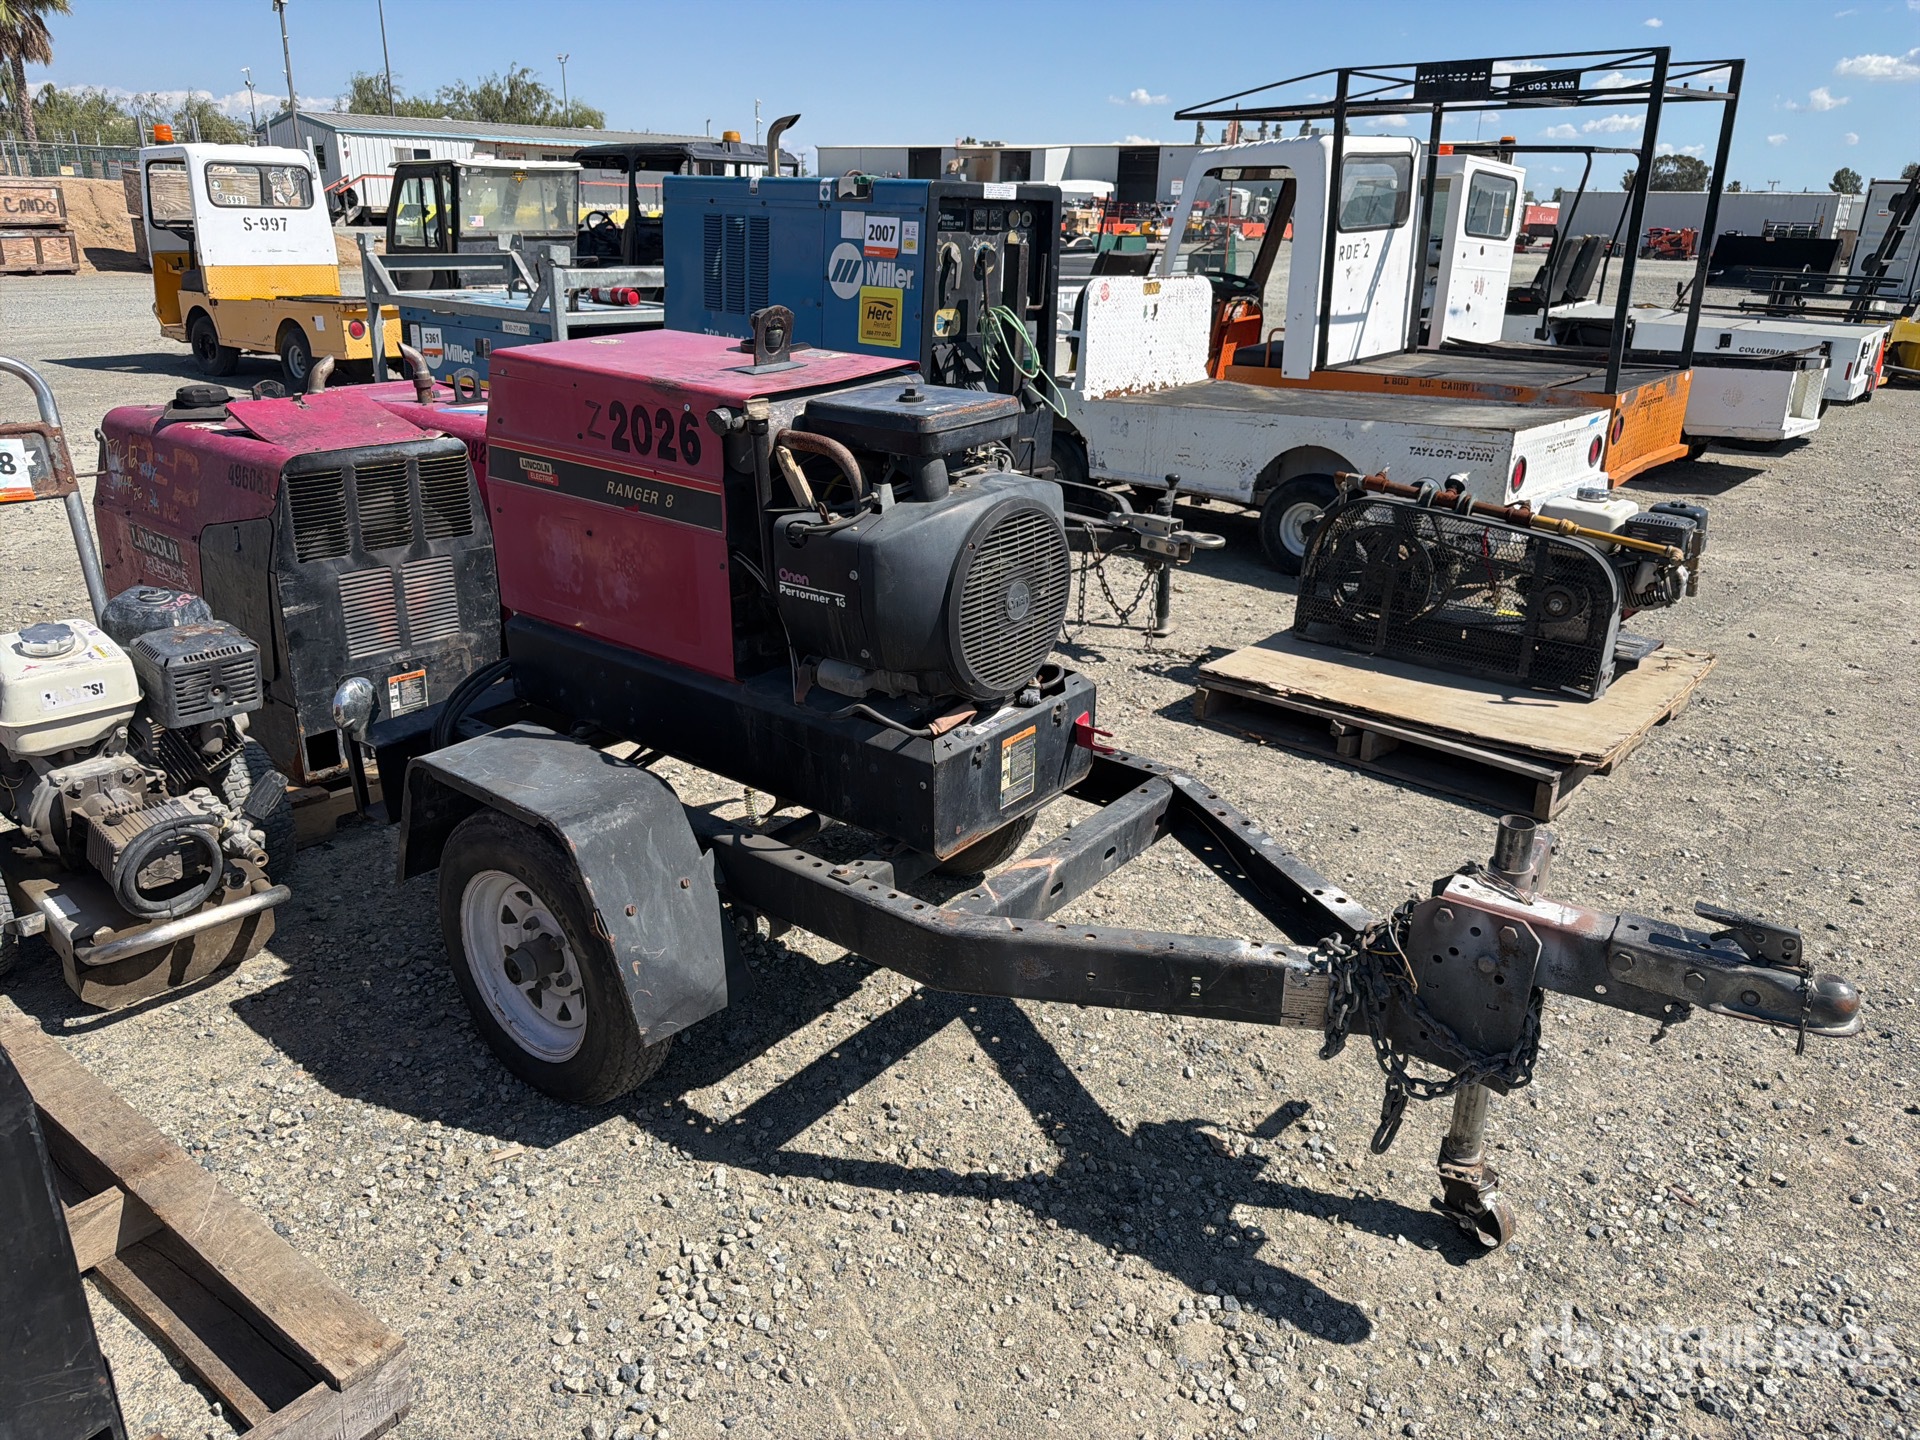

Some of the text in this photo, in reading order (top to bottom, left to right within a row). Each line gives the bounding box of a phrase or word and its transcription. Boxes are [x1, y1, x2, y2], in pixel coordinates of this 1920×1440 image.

[3, 197, 56, 213] CONDO
[226, 195, 246, 204] S997
[243, 216, 287, 231] S-997
[868, 224, 896, 242] 2007
[866, 260, 914, 289] Miller
[867, 305, 893, 321] Herc
[425, 333, 440, 344] 5361
[444, 343, 475, 364] Miller
[1409, 446, 1495, 463] TAYLOR-DUNN
[521, 459, 551, 473] LINCOLN
[529, 473, 554, 484] ELECTRIC
[606, 481, 674, 508] RANGER 8
[778, 567, 810, 586] Onan
